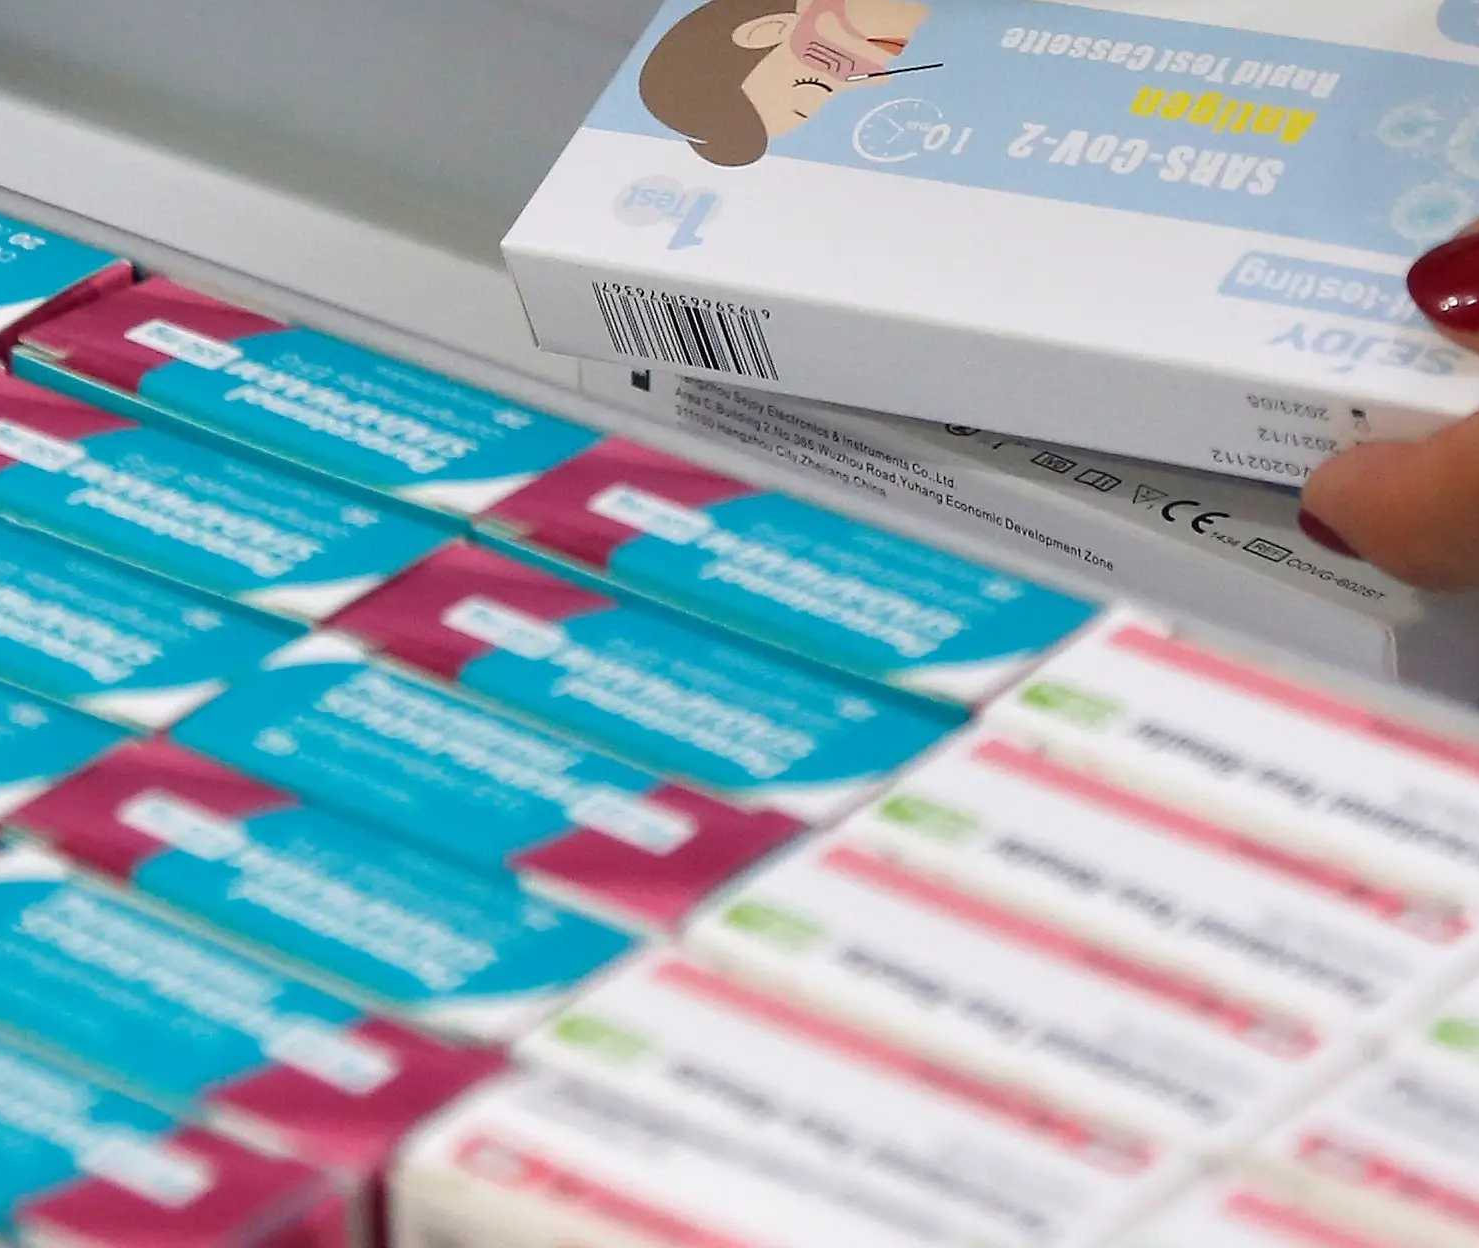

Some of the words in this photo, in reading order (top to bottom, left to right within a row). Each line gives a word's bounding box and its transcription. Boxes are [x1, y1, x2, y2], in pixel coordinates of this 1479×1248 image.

[1000, 26, 1156, 72] Cassette
[1154, 47, 1232, 84] Test
[1230, 58, 1341, 99] Rapid
[1128, 85, 1319, 145] Antigen
[922, 123, 973, 155] 10
[1006, 121, 1286, 197] SARS-CoV-2
[766, 404, 830, 438] Electronics
[832, 430, 841, 443] &
[841, 434, 911, 472] Instruments
[945, 494, 1004, 527] Economic
[1004, 517, 1082, 558] Development
[1082, 549, 1115, 572] Zone
[1286, 557, 1387, 602] COVG-602ST
